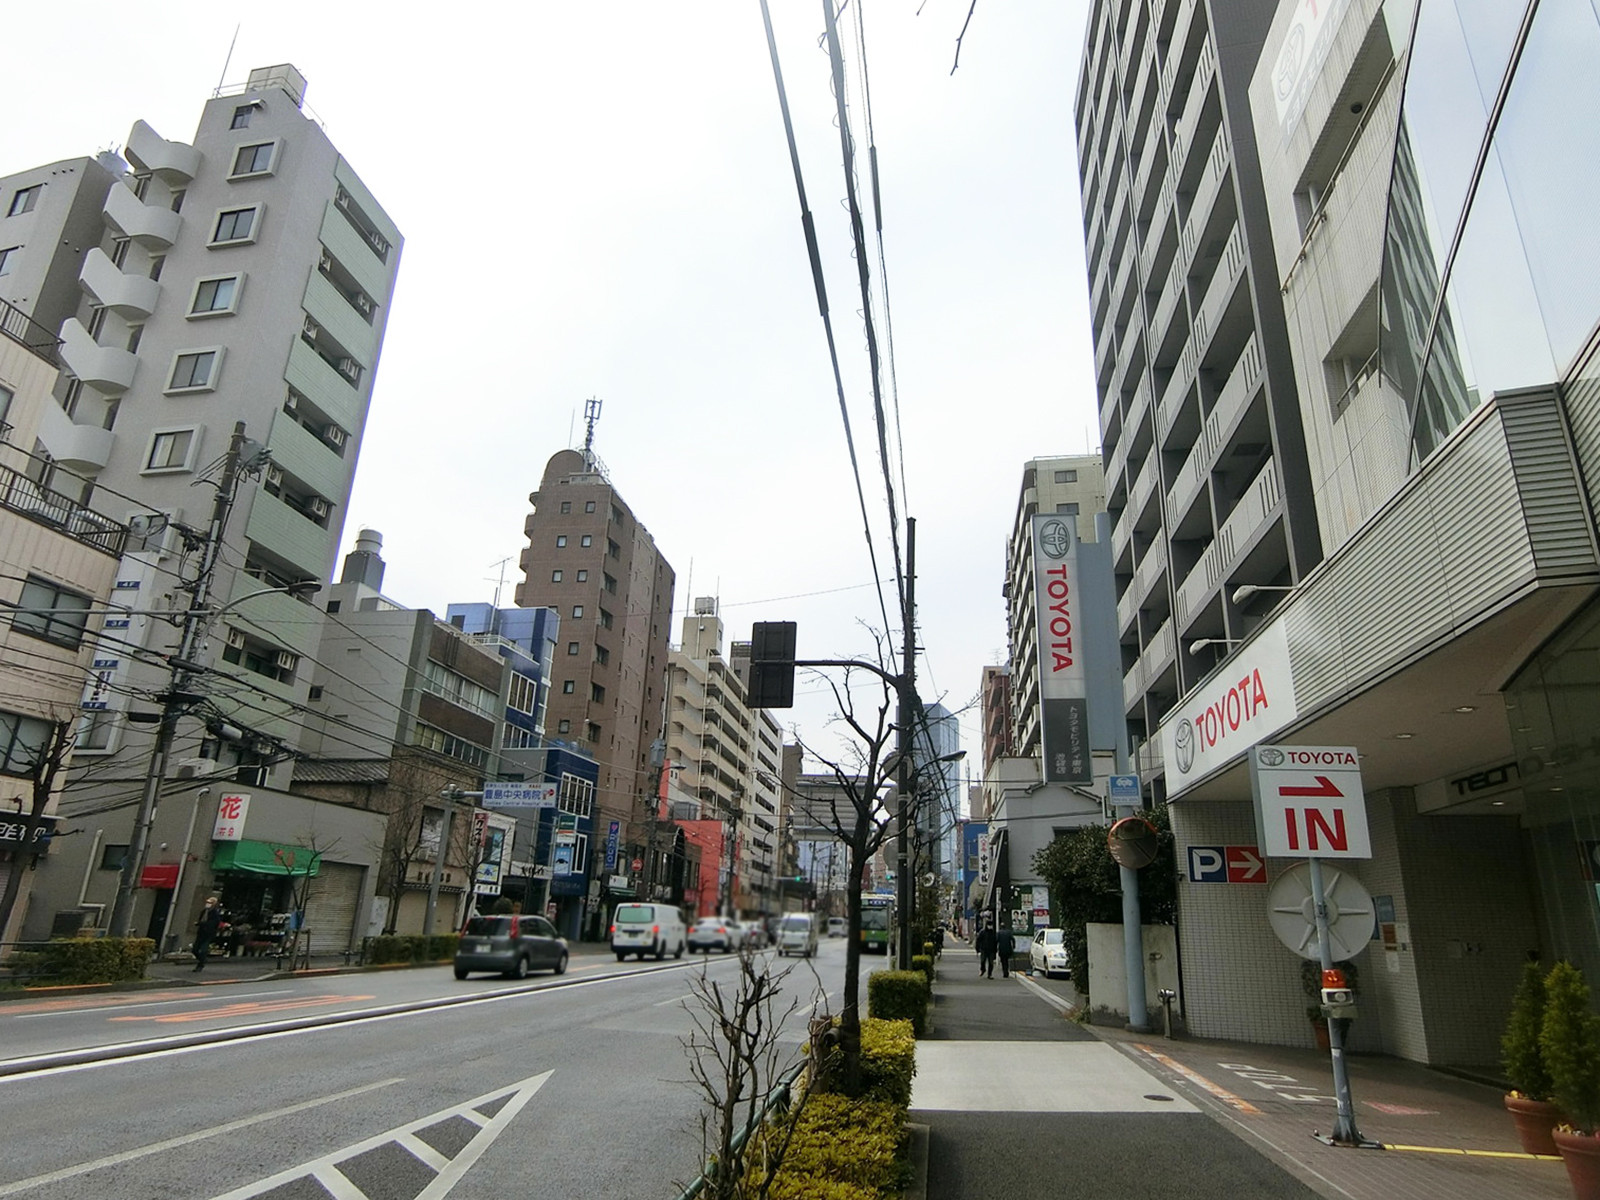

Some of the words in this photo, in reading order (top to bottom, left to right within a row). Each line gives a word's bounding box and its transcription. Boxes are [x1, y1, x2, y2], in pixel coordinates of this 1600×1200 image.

[1046, 564, 1073, 673] TOYOTA
[1194, 668, 1269, 753] TOYOTA
[1287, 750, 1357, 766] TOYOTA
[220, 796, 243, 820] 花
[1285, 808, 1349, 851] IN
[1192, 849, 1223, 881] P
